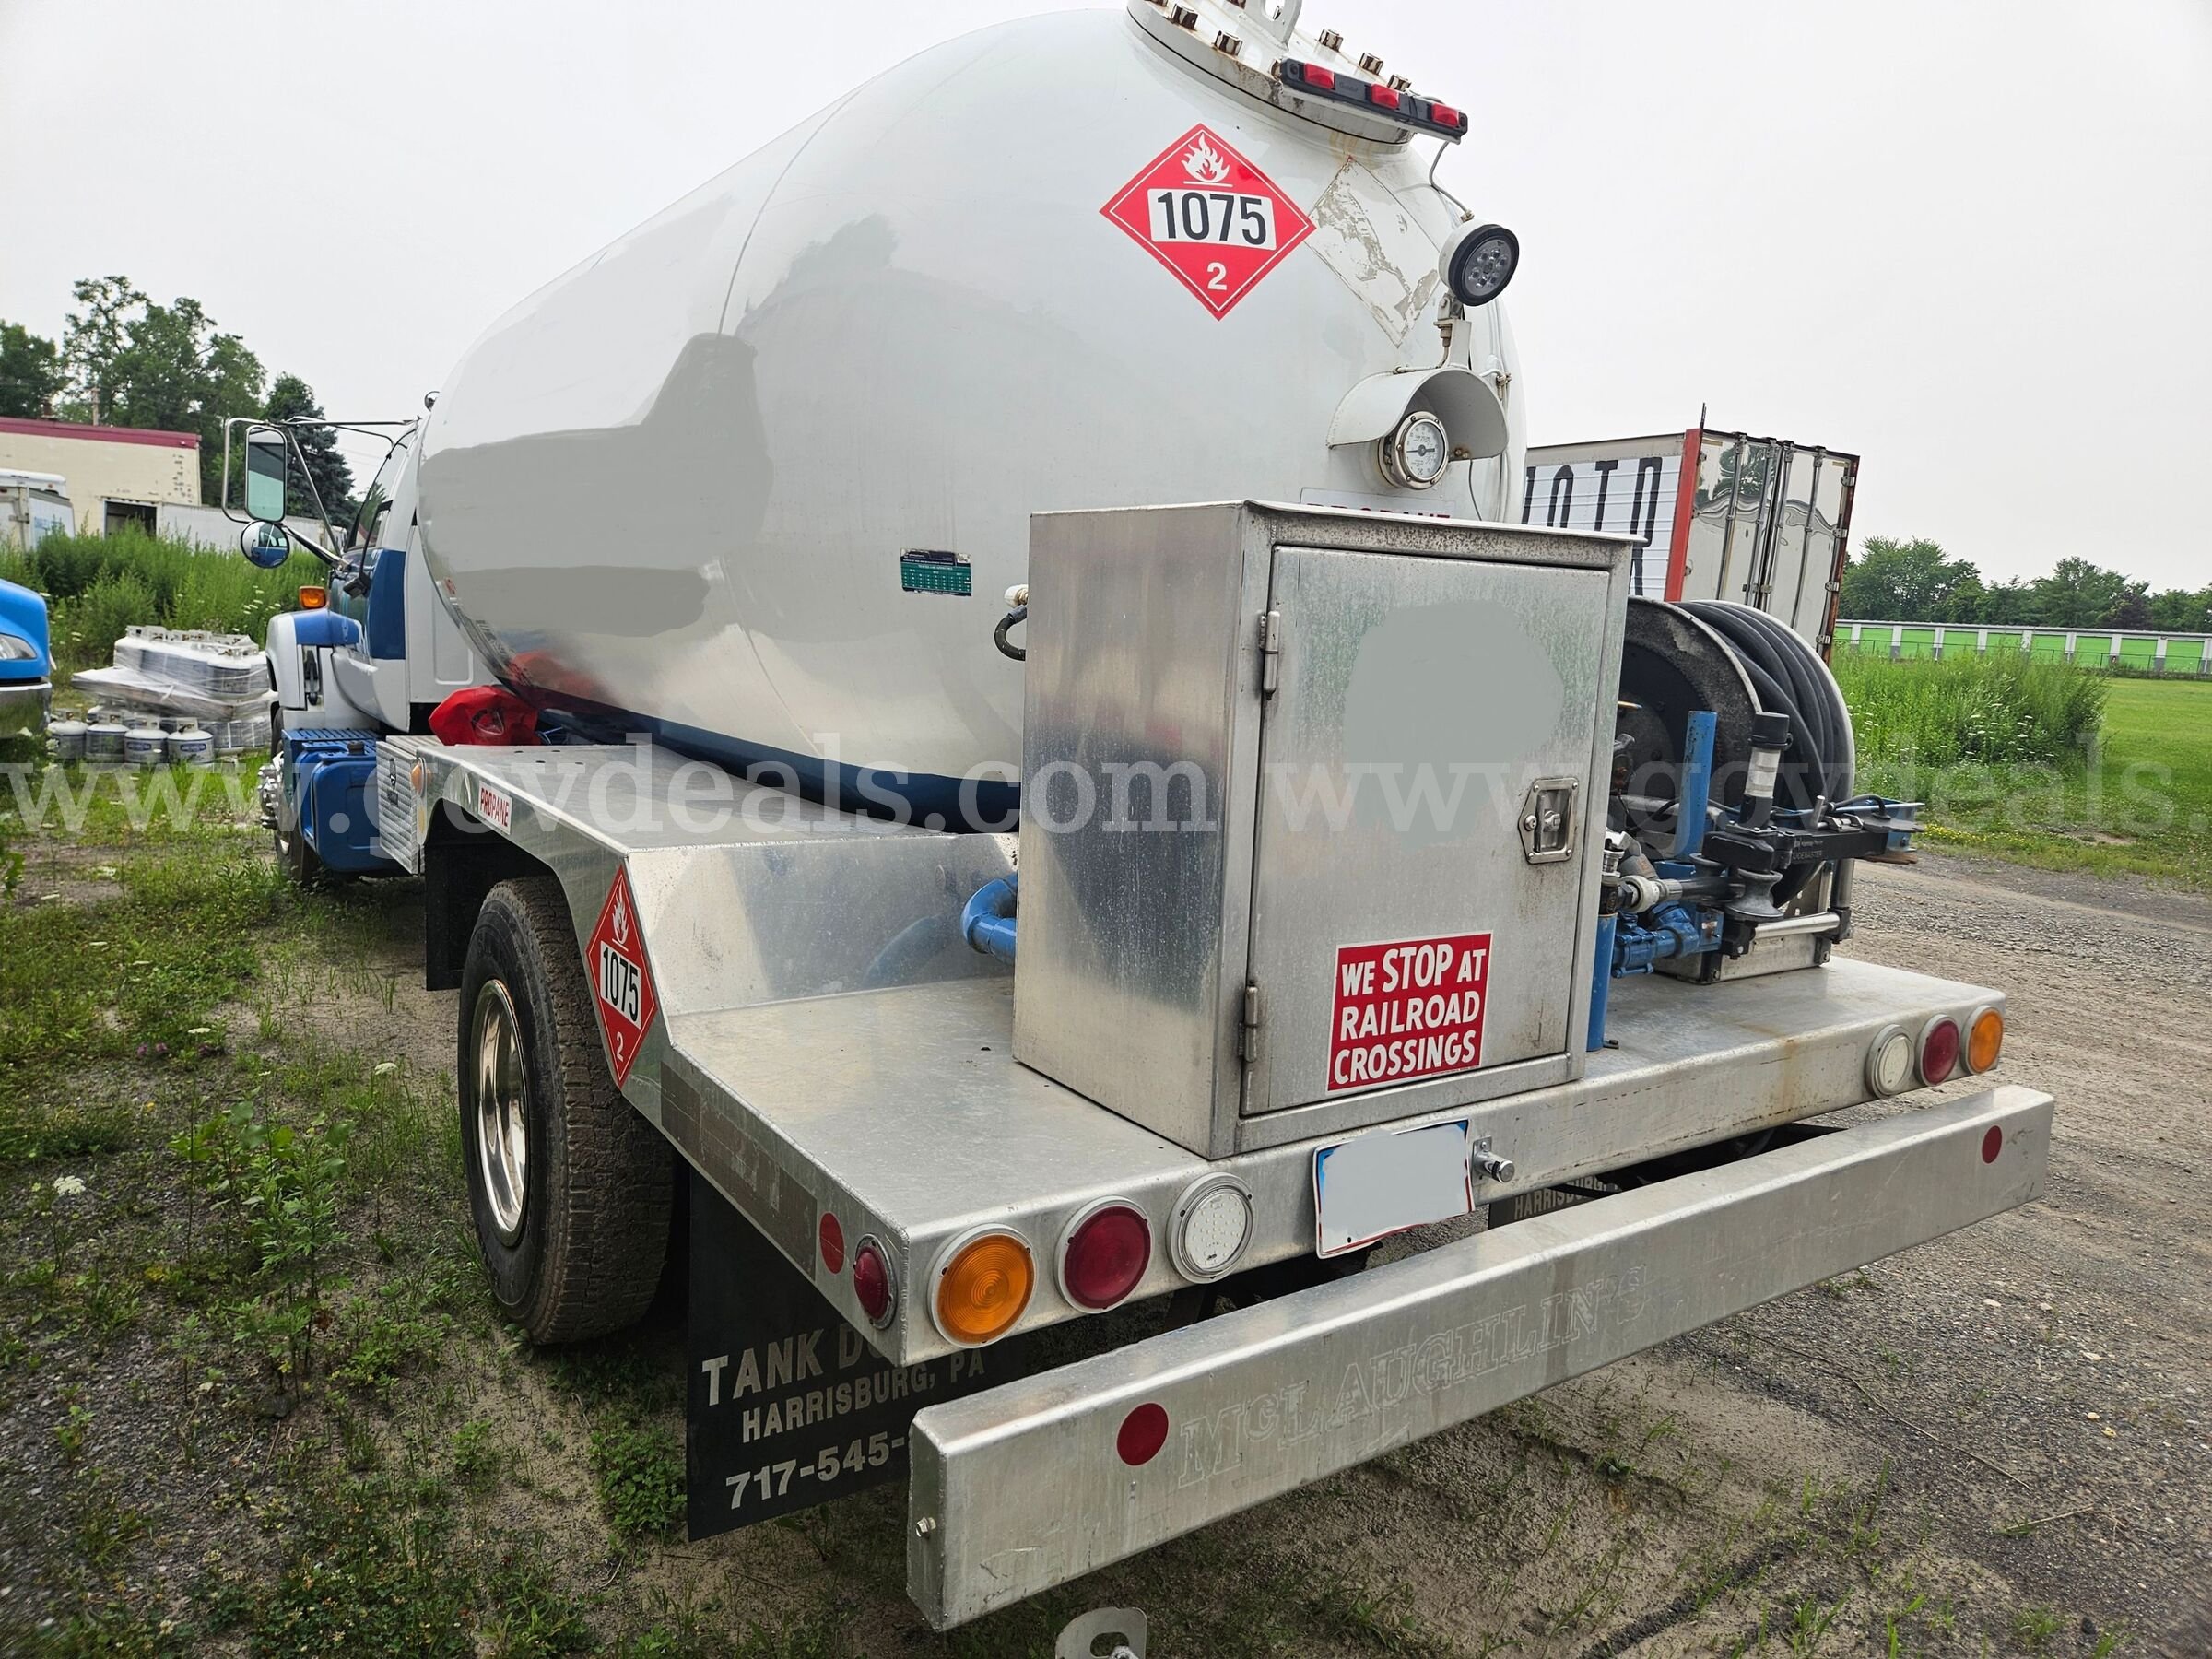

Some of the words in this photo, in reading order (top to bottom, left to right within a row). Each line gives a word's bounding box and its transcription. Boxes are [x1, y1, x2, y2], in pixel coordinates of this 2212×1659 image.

[1158, 192, 1266, 245] 1075
[1206, 262, 1228, 290] 2
[480, 787, 510, 827] PROPANE
[603, 947, 639, 1022] 1075
[1342, 960, 1375, 997] WE
[1382, 943, 1453, 993] STOP
[1456, 949, 1487, 983] AT
[1340, 991, 1480, 1041] RAILROAD
[616, 1031, 624, 1062] 2
[1334, 1030, 1477, 1085] CROSSINGS
[701, 1328, 824, 1406] TANK
[742, 1364, 936, 1444] HARRISBURG,
[950, 1348, 985, 1384] PA
